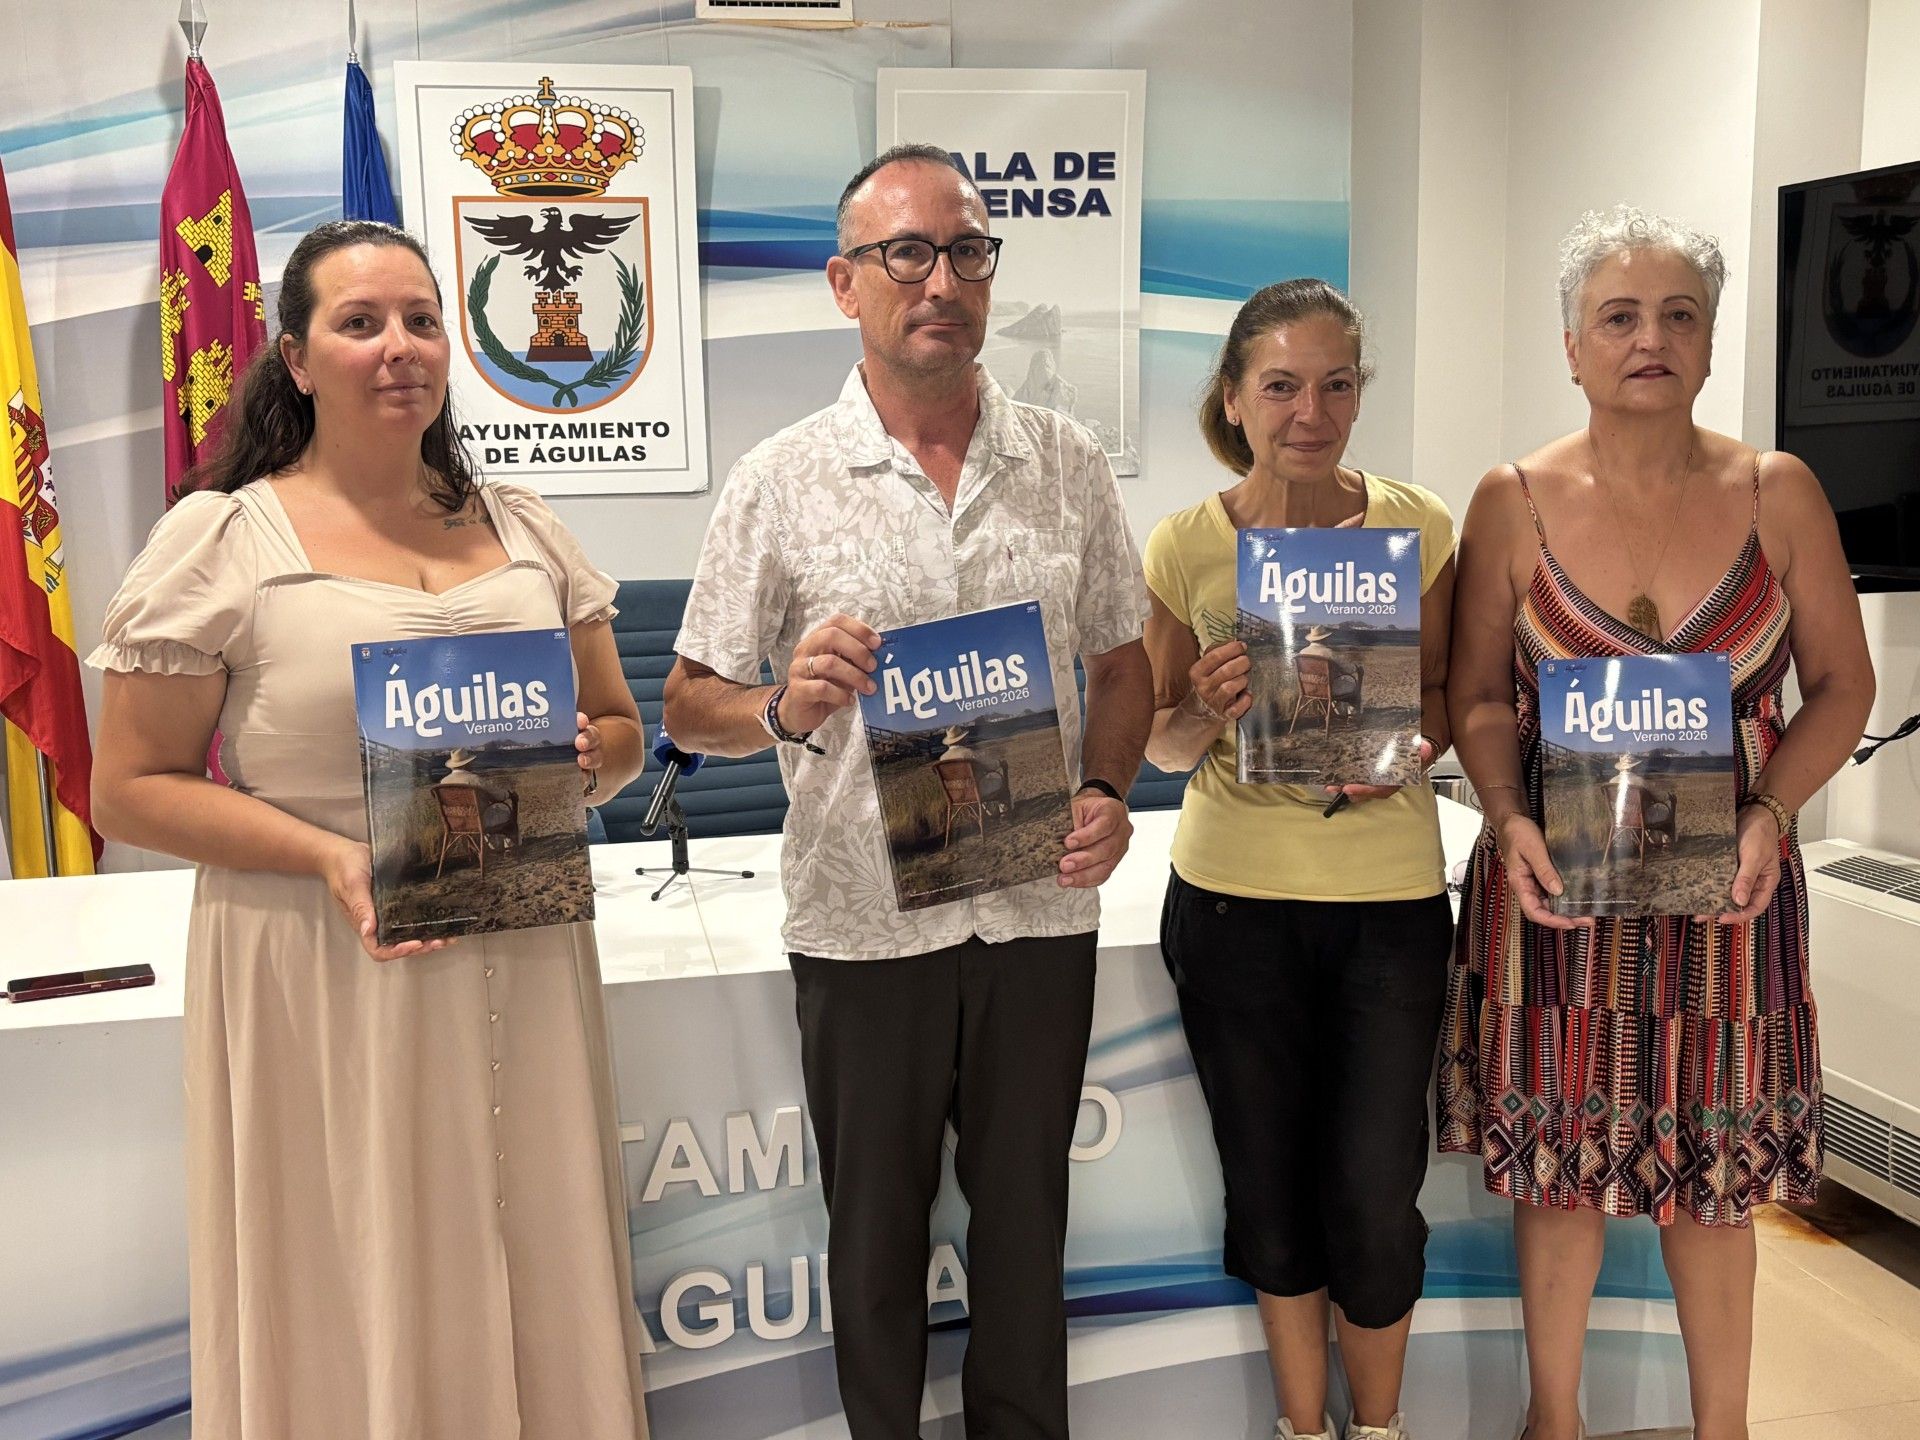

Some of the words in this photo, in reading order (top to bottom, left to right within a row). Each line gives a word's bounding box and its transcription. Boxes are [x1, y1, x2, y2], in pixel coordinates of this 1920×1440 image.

[949, 151, 1037, 181] ALA
[1053, 151, 1116, 181] DE
[980, 188, 1112, 218] ENSA
[459, 421, 671, 441] AYUNTAMIENTO
[485, 447, 520, 464] DE
[529, 443, 647, 464] ÁGUILAS
[1259, 548, 1398, 614] Águilas
[1324, 604, 1365, 615] Verano
[1368, 604, 1396, 615] 2026
[883, 650, 1029, 720] Águilas
[385, 663, 550, 738] Águilas
[955, 695, 999, 712] Verano
[1000, 687, 1030, 703] 2026
[1564, 678, 1709, 742] Águilas
[464, 720, 513, 735] Verano
[516, 717, 550, 731] 2026
[1632, 731, 1676, 742] Verano
[1678, 730, 1709, 741] 2026
